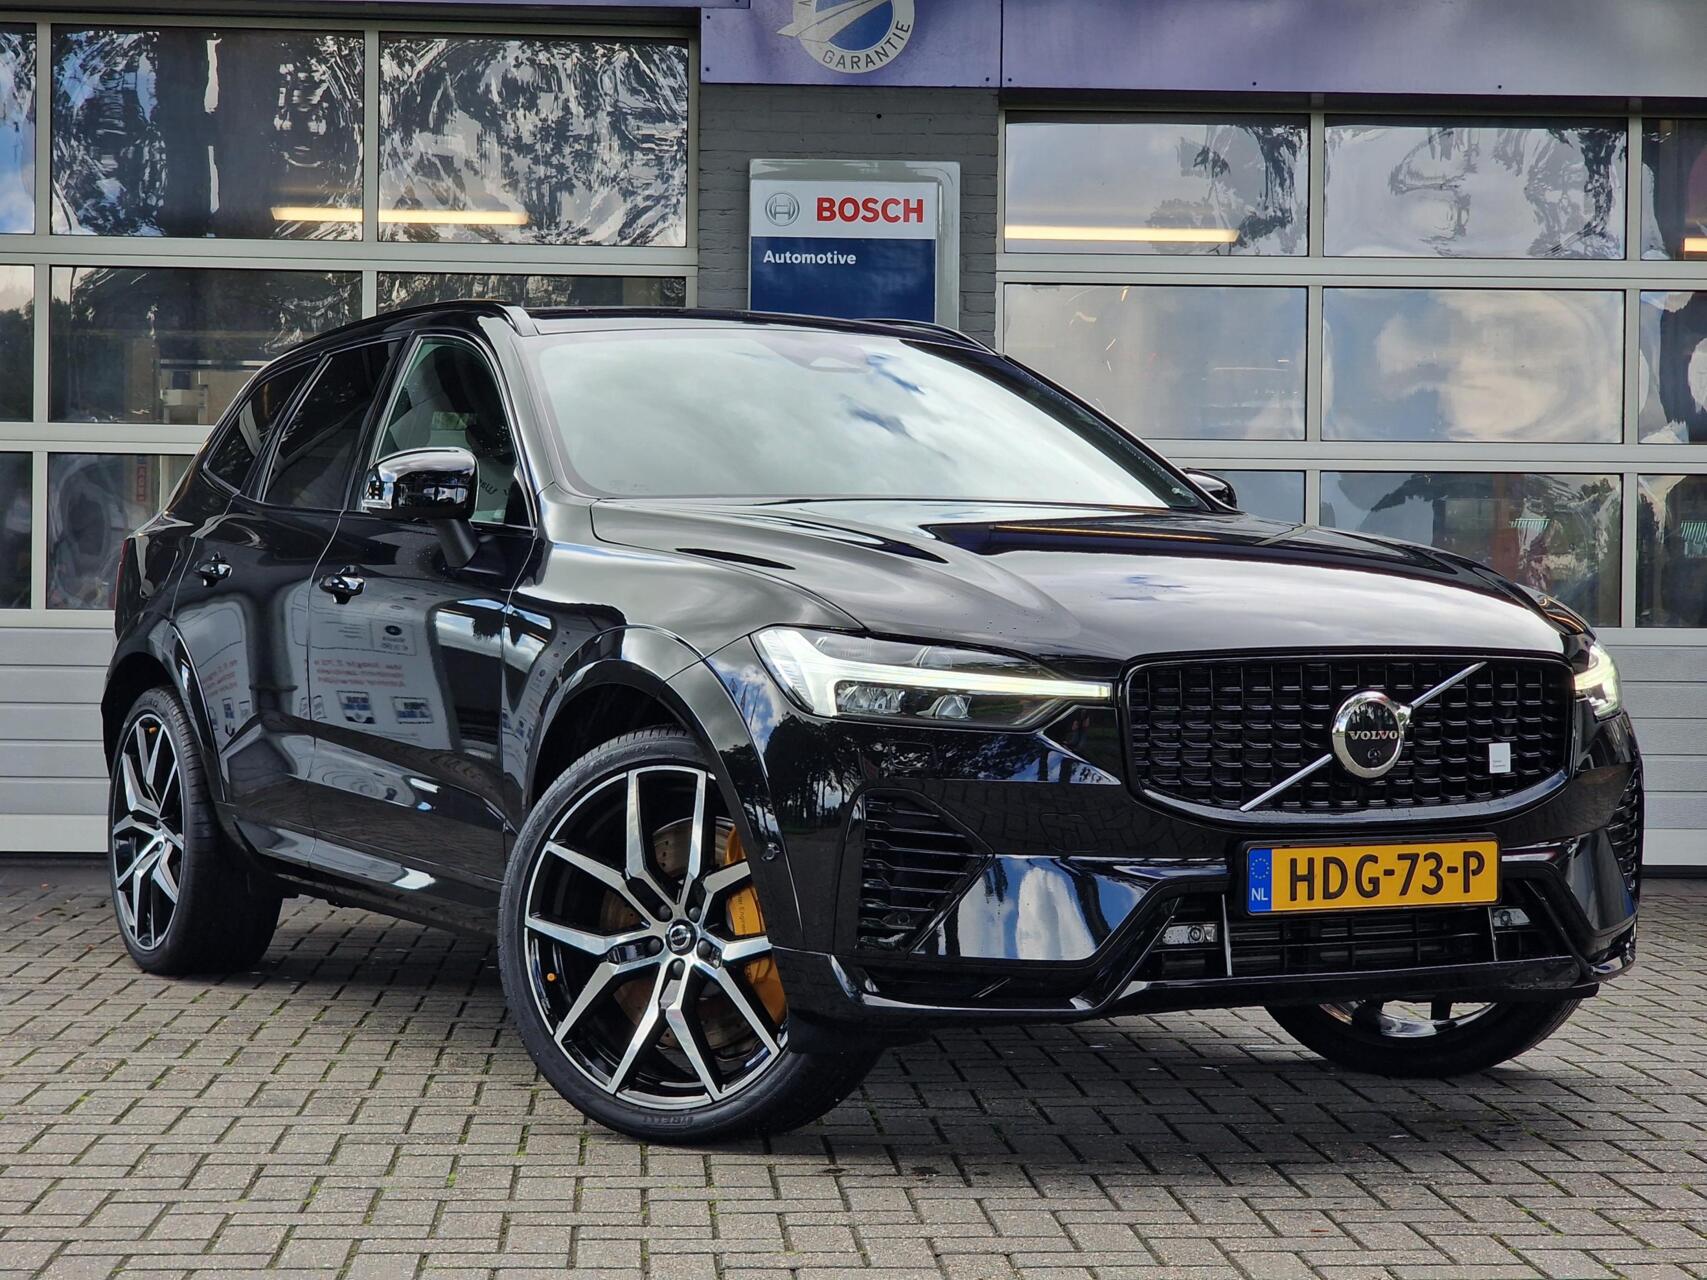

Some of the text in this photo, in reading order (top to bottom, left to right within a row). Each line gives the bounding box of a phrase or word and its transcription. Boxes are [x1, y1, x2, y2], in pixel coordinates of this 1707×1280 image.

[822, 20, 911, 70] GARANTIE
[816, 197, 924, 223] BOSCH
[763, 250, 857, 265] Automotive
[1348, 730, 1398, 741] VOLVO
[1289, 851, 1486, 902] HDG-73-P
[1251, 887, 1269, 901] NL
